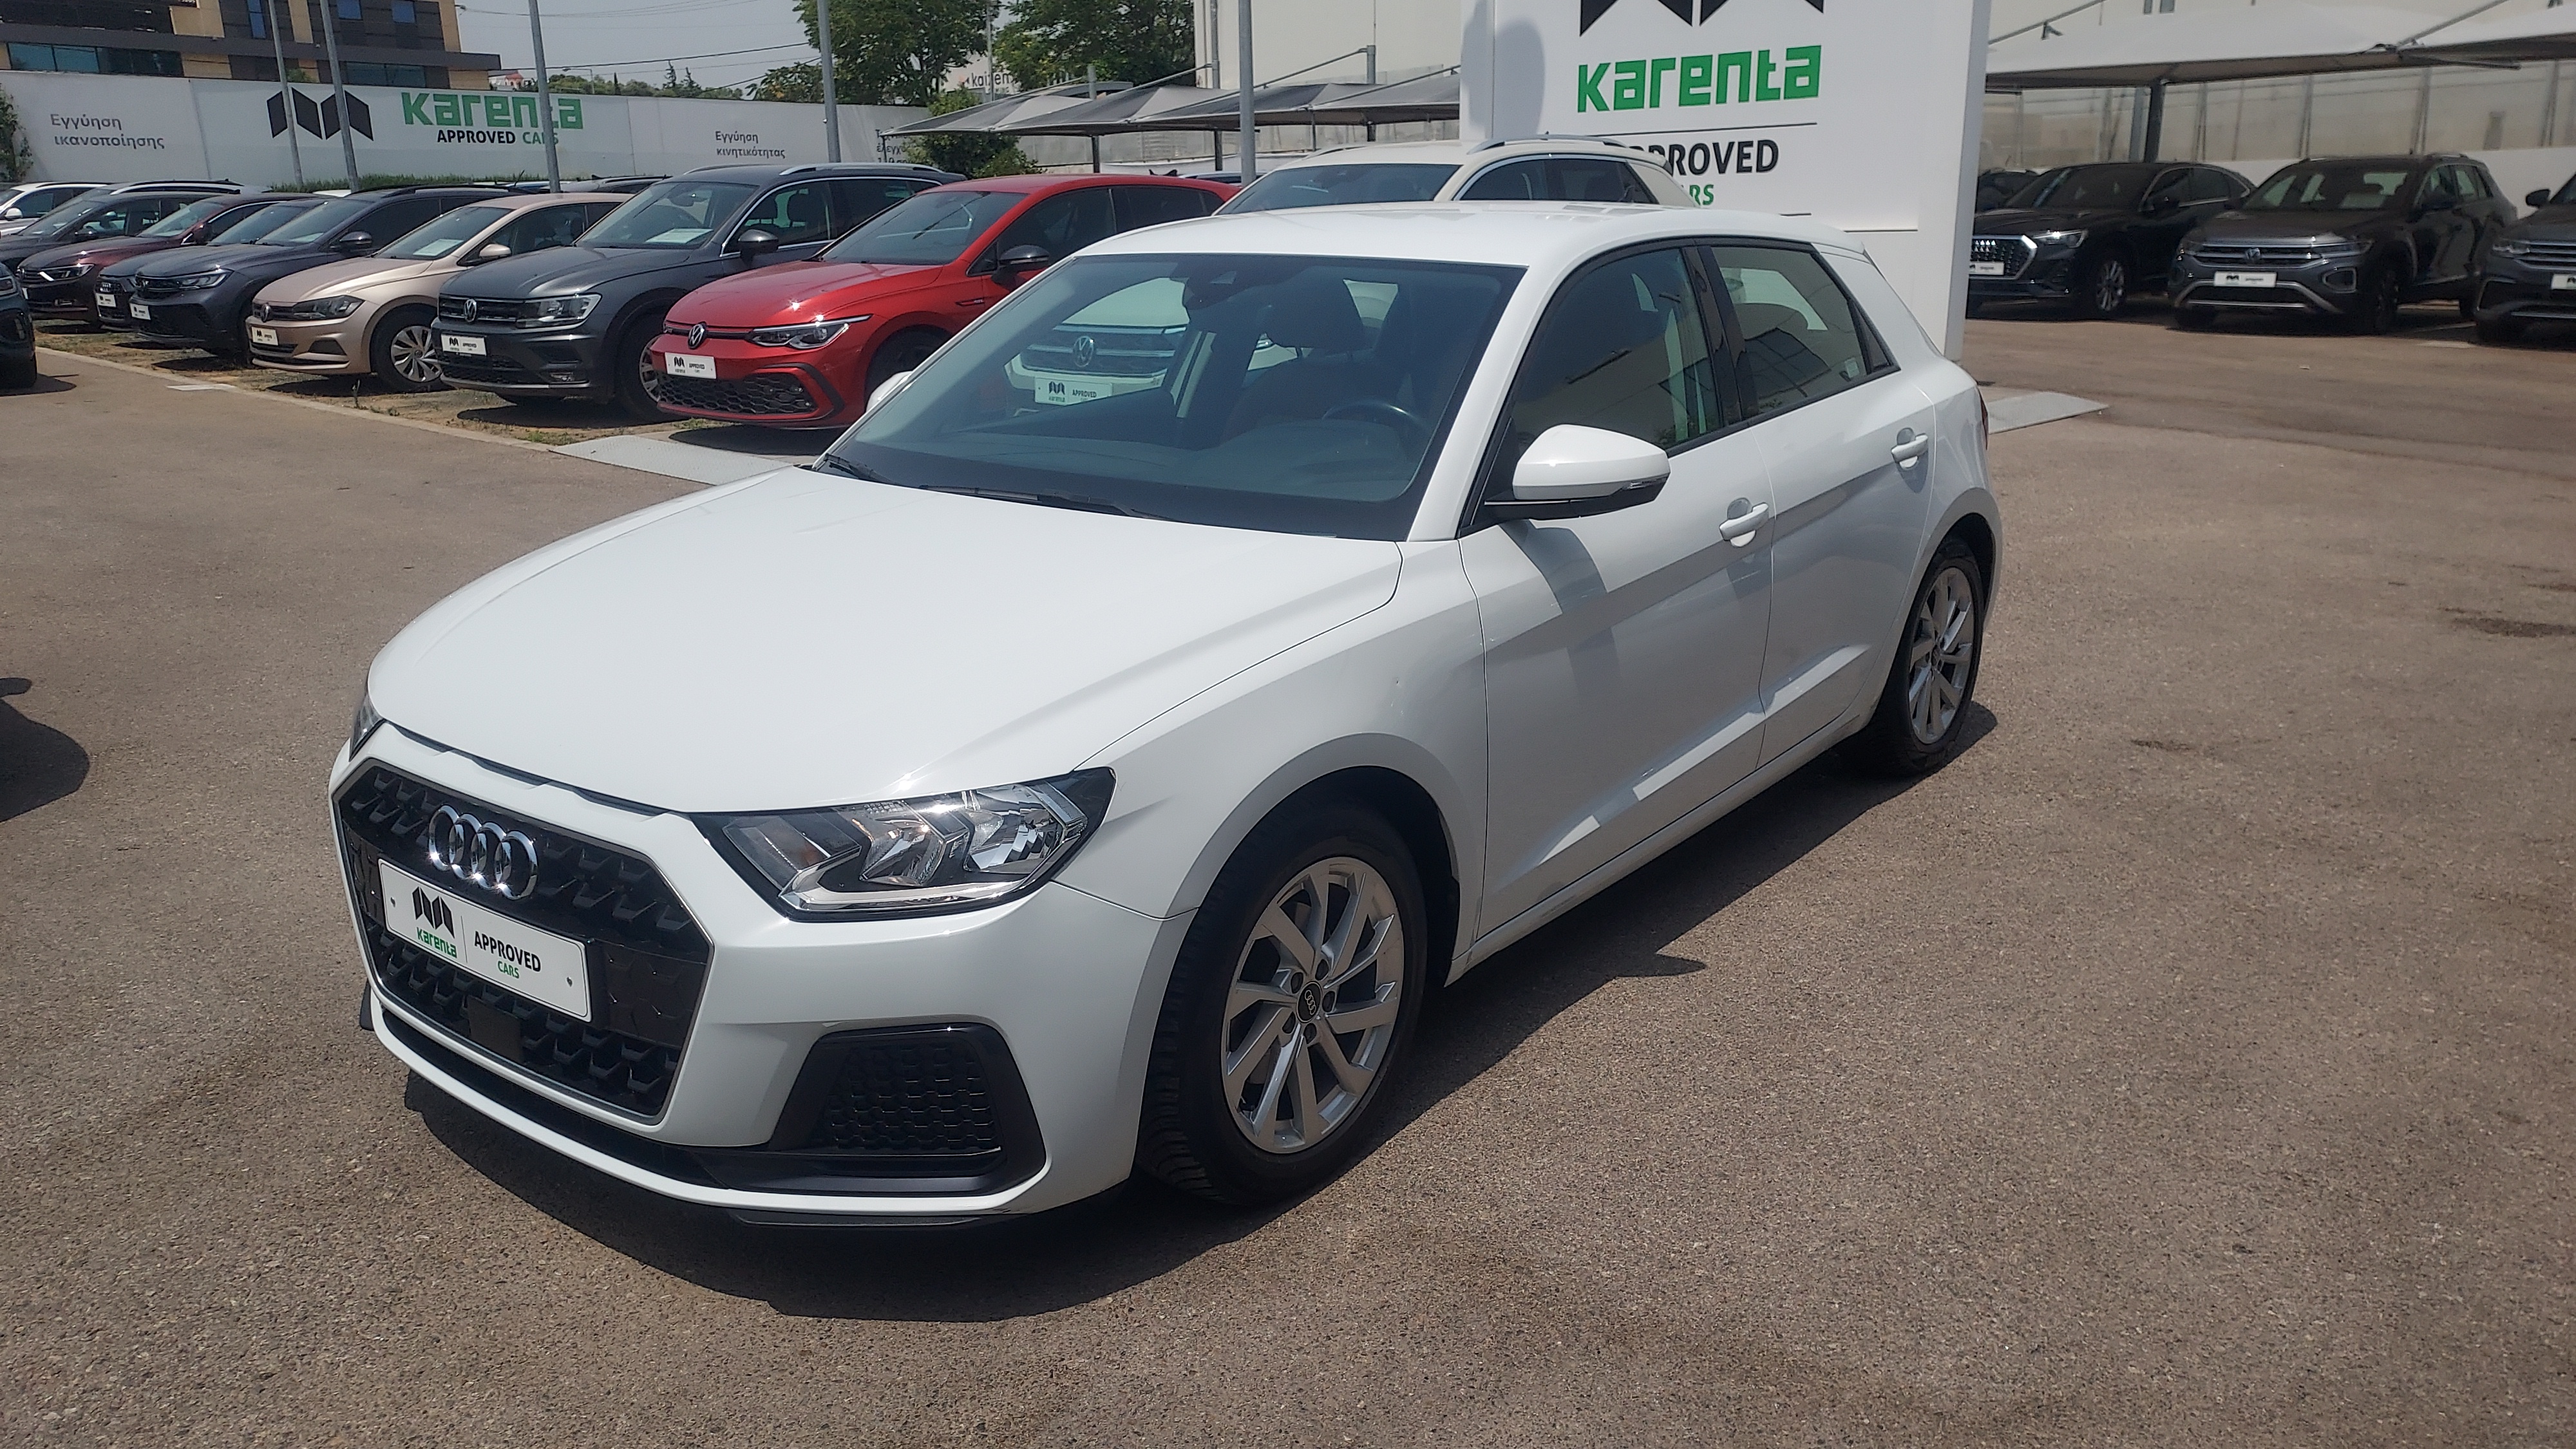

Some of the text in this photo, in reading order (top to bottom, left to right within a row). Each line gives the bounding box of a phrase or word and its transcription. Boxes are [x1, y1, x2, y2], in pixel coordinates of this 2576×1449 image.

[50, 113, 122, 130] Εγγύηση
[54, 133, 165, 149] ικανοποίησης
[437, 129, 516, 144] APPROVED
[715, 131, 759, 144] Εγγύηση
[716, 146, 786, 159] κινητικότητας
[1072, 389, 1097, 398] APPROVED
[474, 931, 541, 972] APPROVED
[497, 960, 520, 979] CARS
